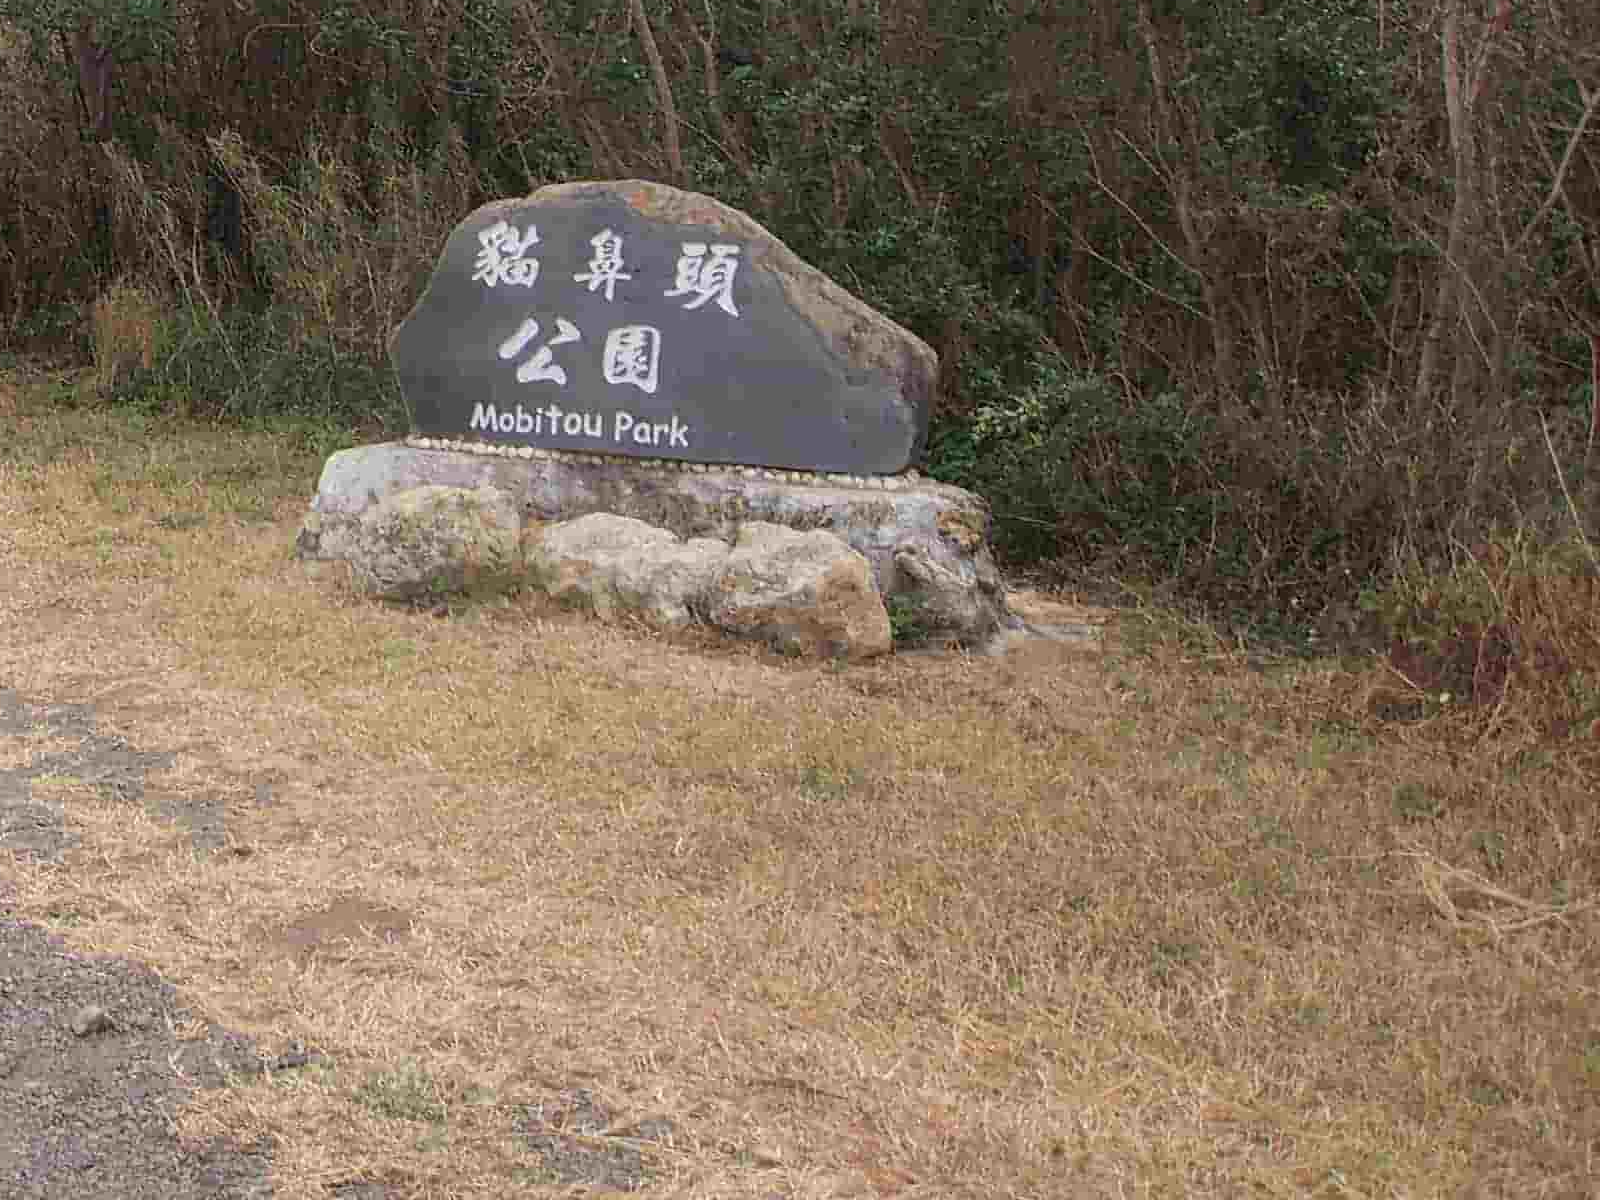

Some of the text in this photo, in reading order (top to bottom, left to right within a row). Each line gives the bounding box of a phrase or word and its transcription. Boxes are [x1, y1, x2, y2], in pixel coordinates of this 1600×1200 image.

[472, 220, 742, 318] 貓鼻頭
[498, 318, 661, 393] 公園
[469, 401, 689, 447] Mobitou Park
